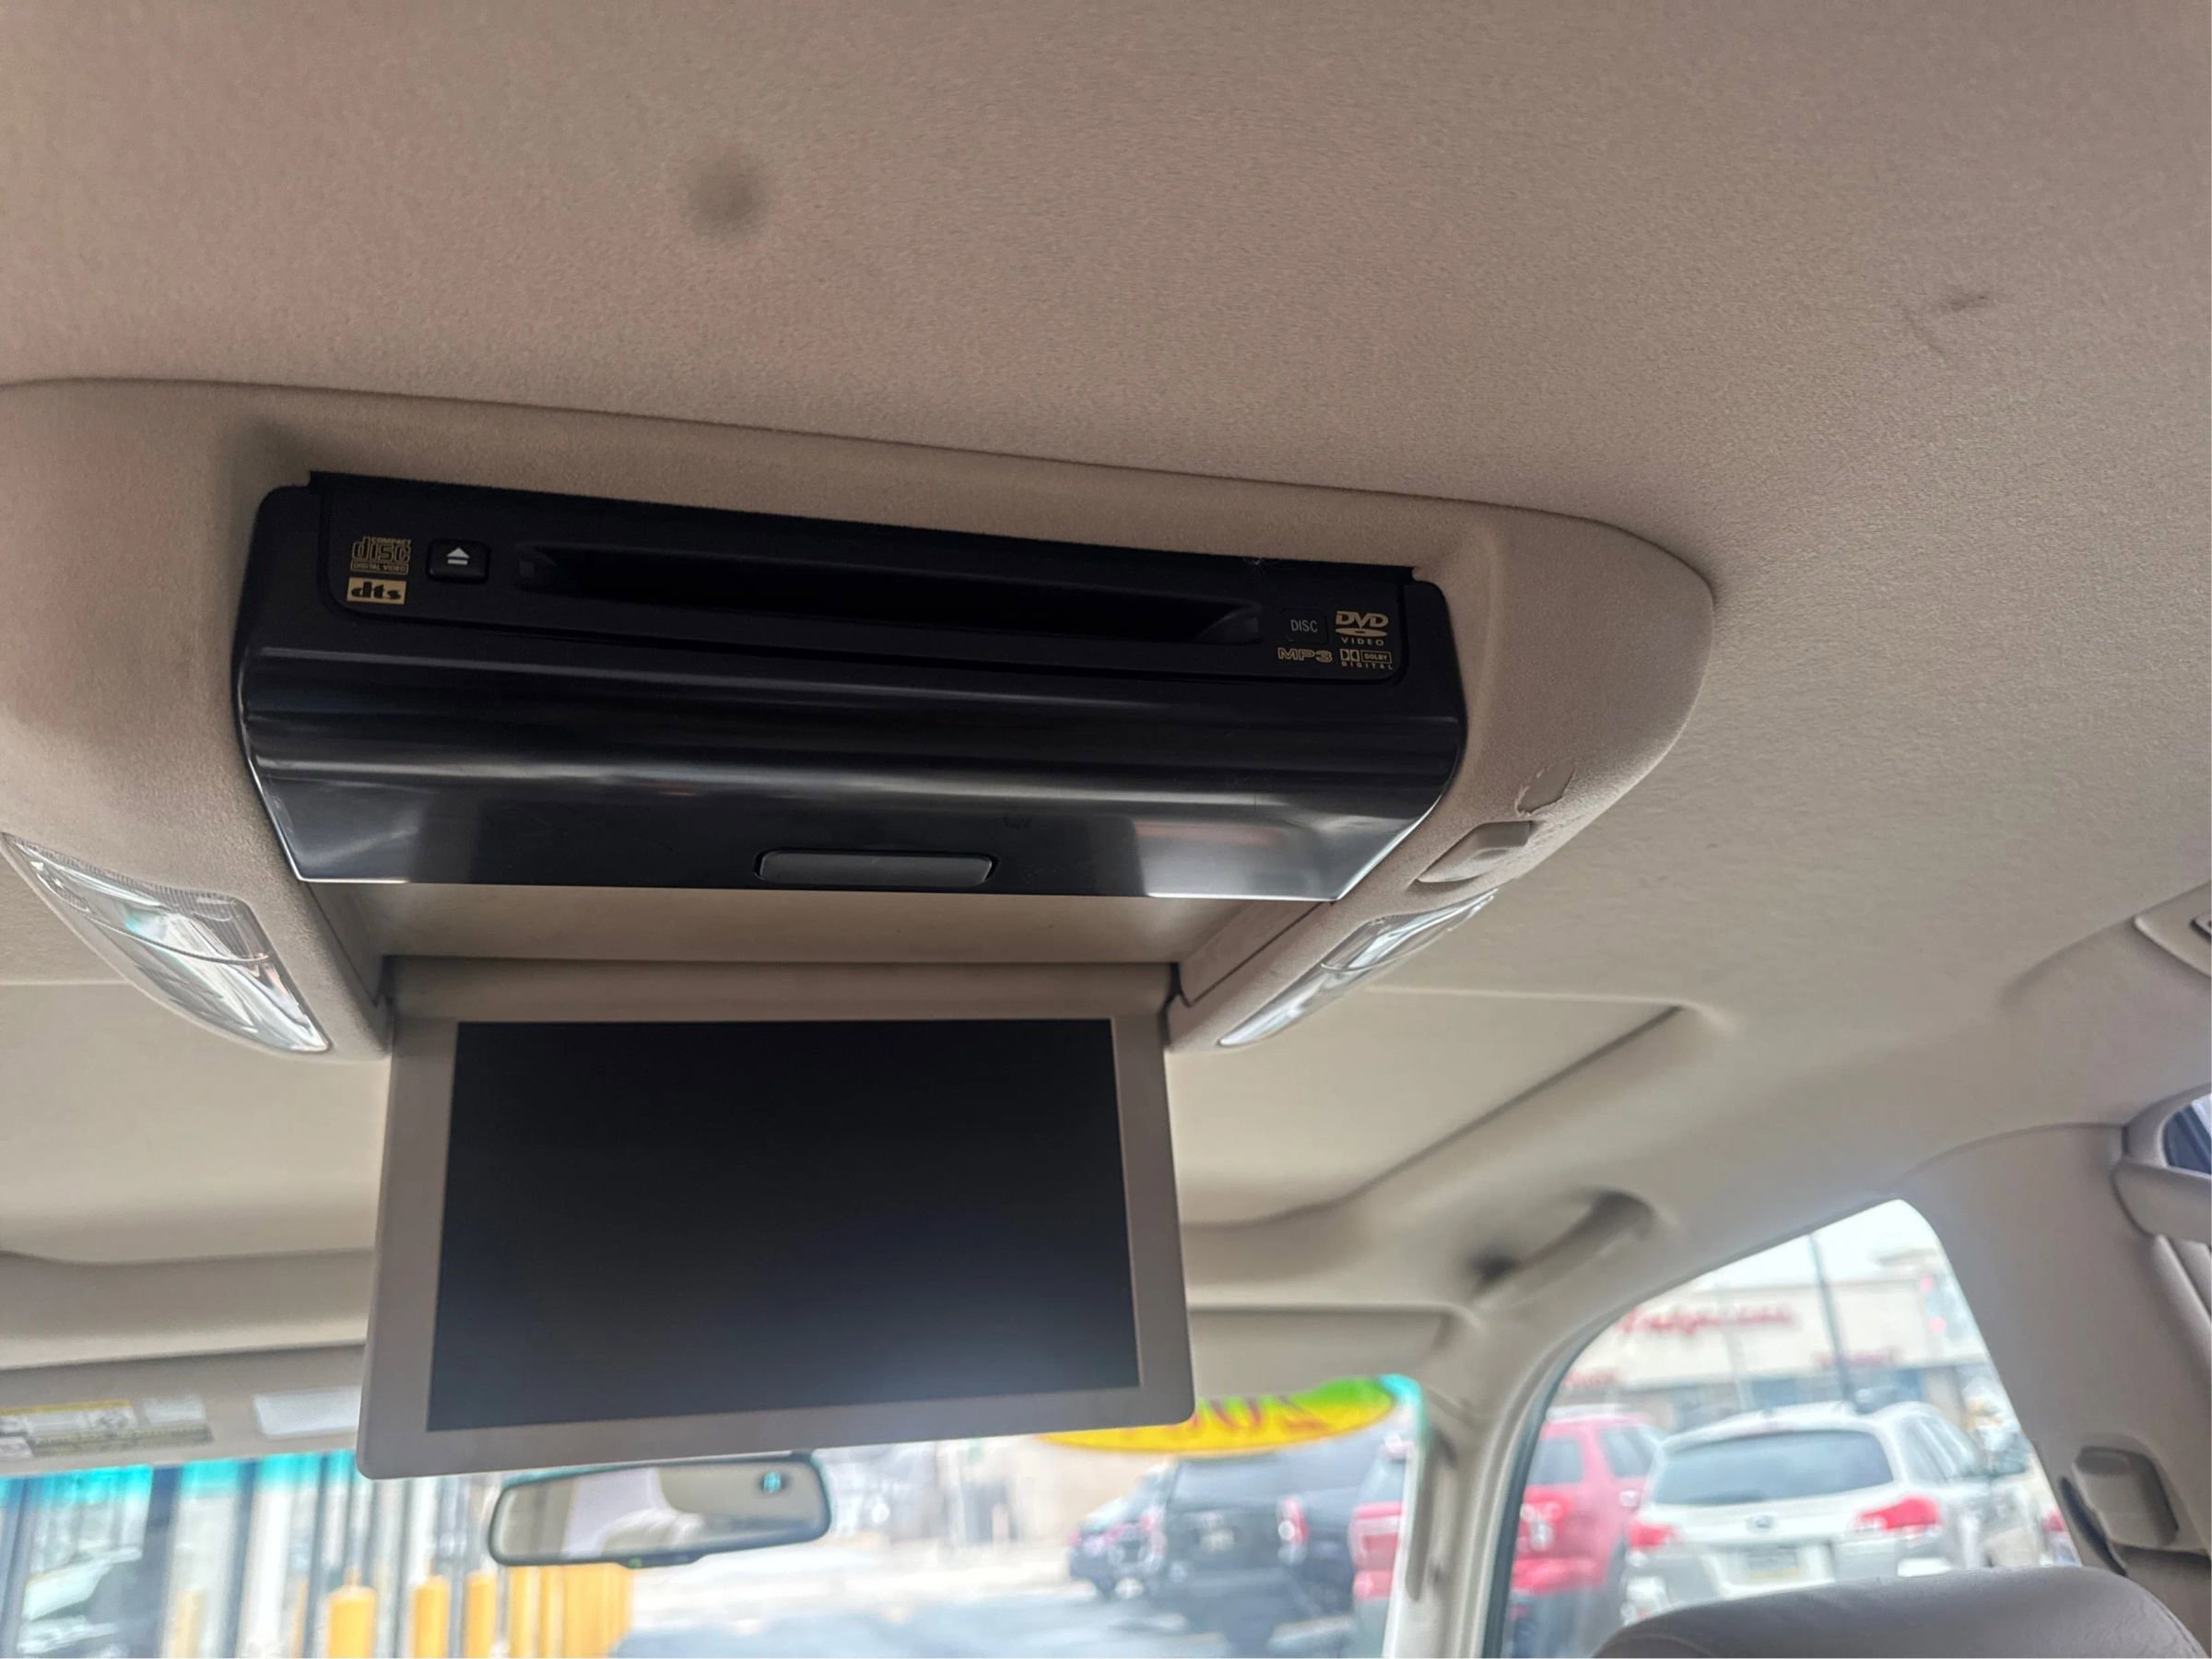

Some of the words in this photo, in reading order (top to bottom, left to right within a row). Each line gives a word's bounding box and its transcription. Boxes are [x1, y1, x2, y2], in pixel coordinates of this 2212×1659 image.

[353, 562, 381, 571] DIGITAL
[382, 563, 406, 571] VIDEO
[351, 582, 401, 599] dts
[1290, 618, 1318, 633] DISC
[1335, 610, 1389, 629] DVD
[1341, 637, 1384, 646] VIDEO
[1277, 647, 1333, 663] MP3
[1364, 652, 1388, 661] DOLBY
[1341, 661, 1394, 670] DIGITAL
